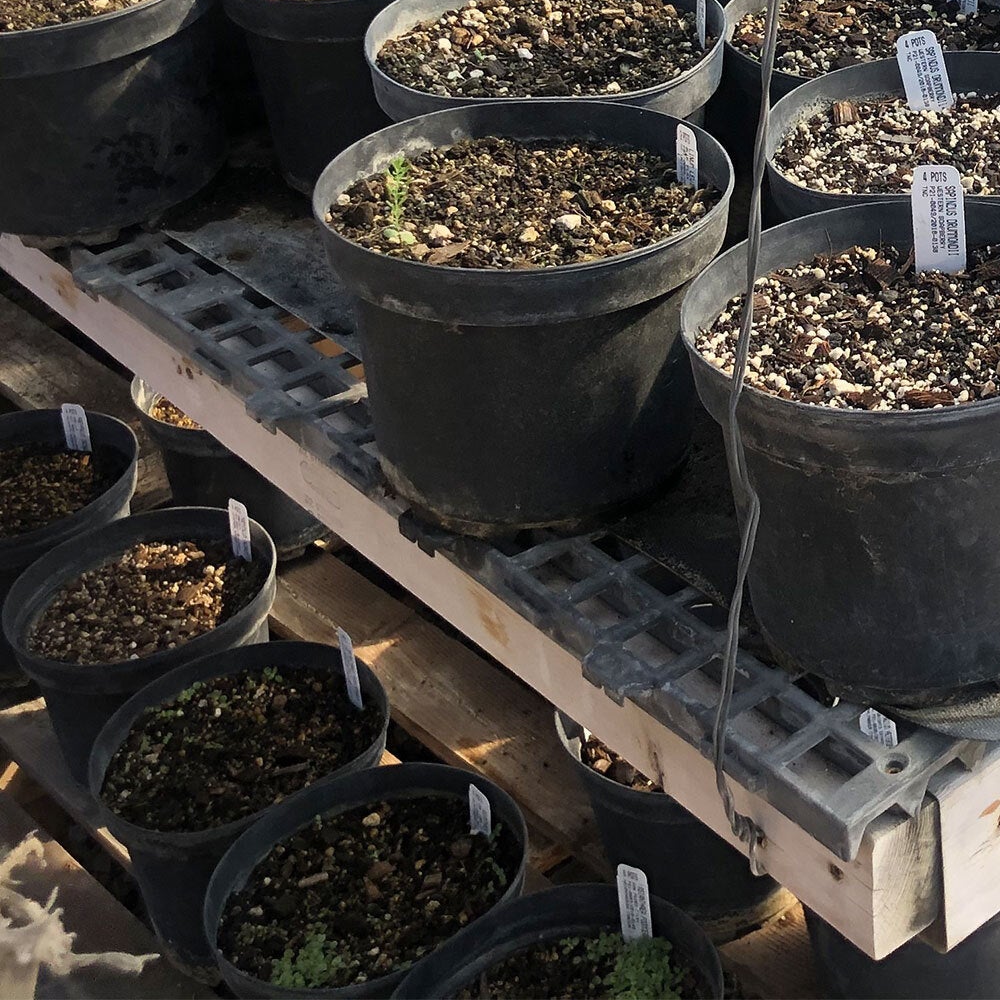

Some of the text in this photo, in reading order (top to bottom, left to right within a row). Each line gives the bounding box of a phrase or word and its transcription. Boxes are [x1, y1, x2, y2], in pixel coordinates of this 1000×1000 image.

[910, 36, 926, 48] POTS
[923, 171, 947, 182] 4 POTS
[938, 216, 946, 249] SOAPBERRY
